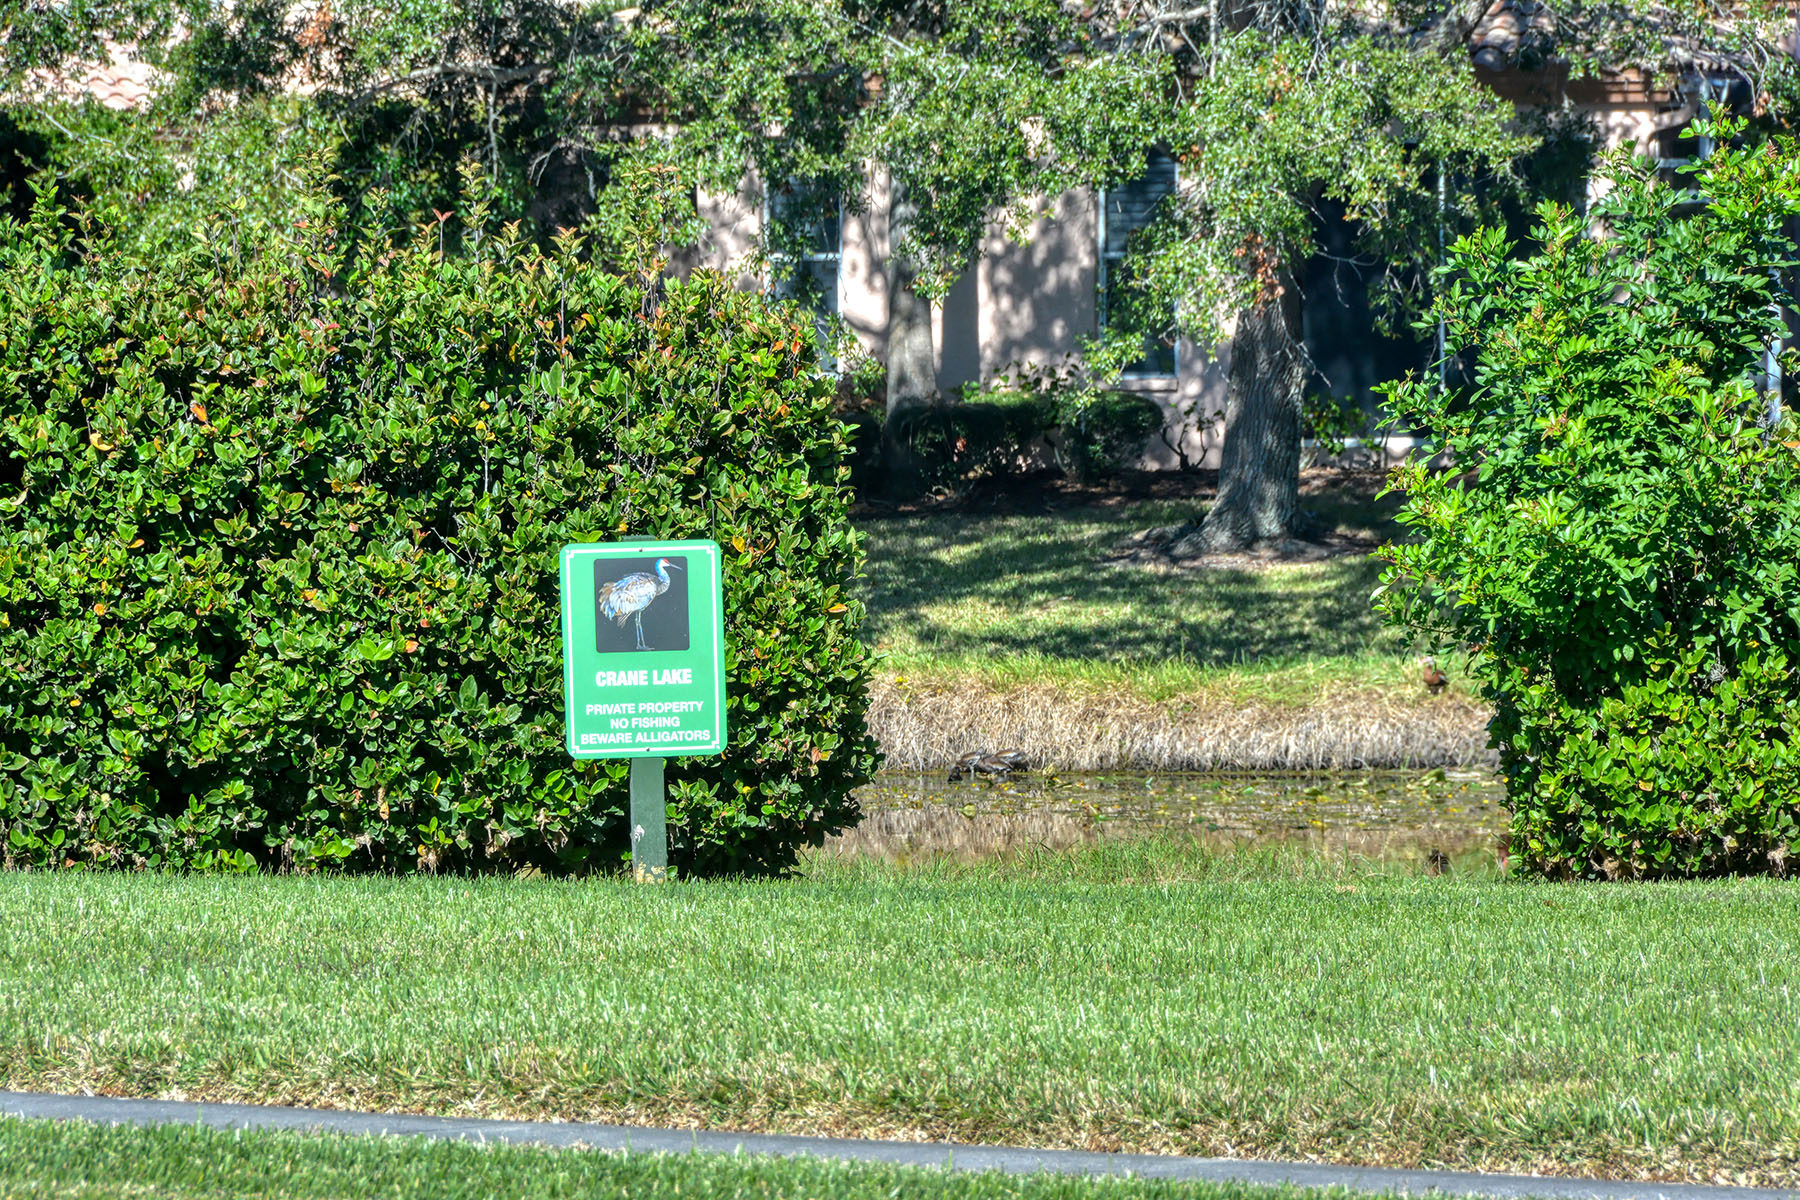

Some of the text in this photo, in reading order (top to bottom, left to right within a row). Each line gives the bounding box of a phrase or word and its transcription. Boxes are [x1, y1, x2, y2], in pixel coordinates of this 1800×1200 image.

[595, 668, 692, 687] CRANE LAKE
[585, 701, 704, 715] PRIVATE PROPERTY
[610, 716, 680, 729] NO FISHING
[580, 730, 711, 745] BEWARE ALLIGATORS
